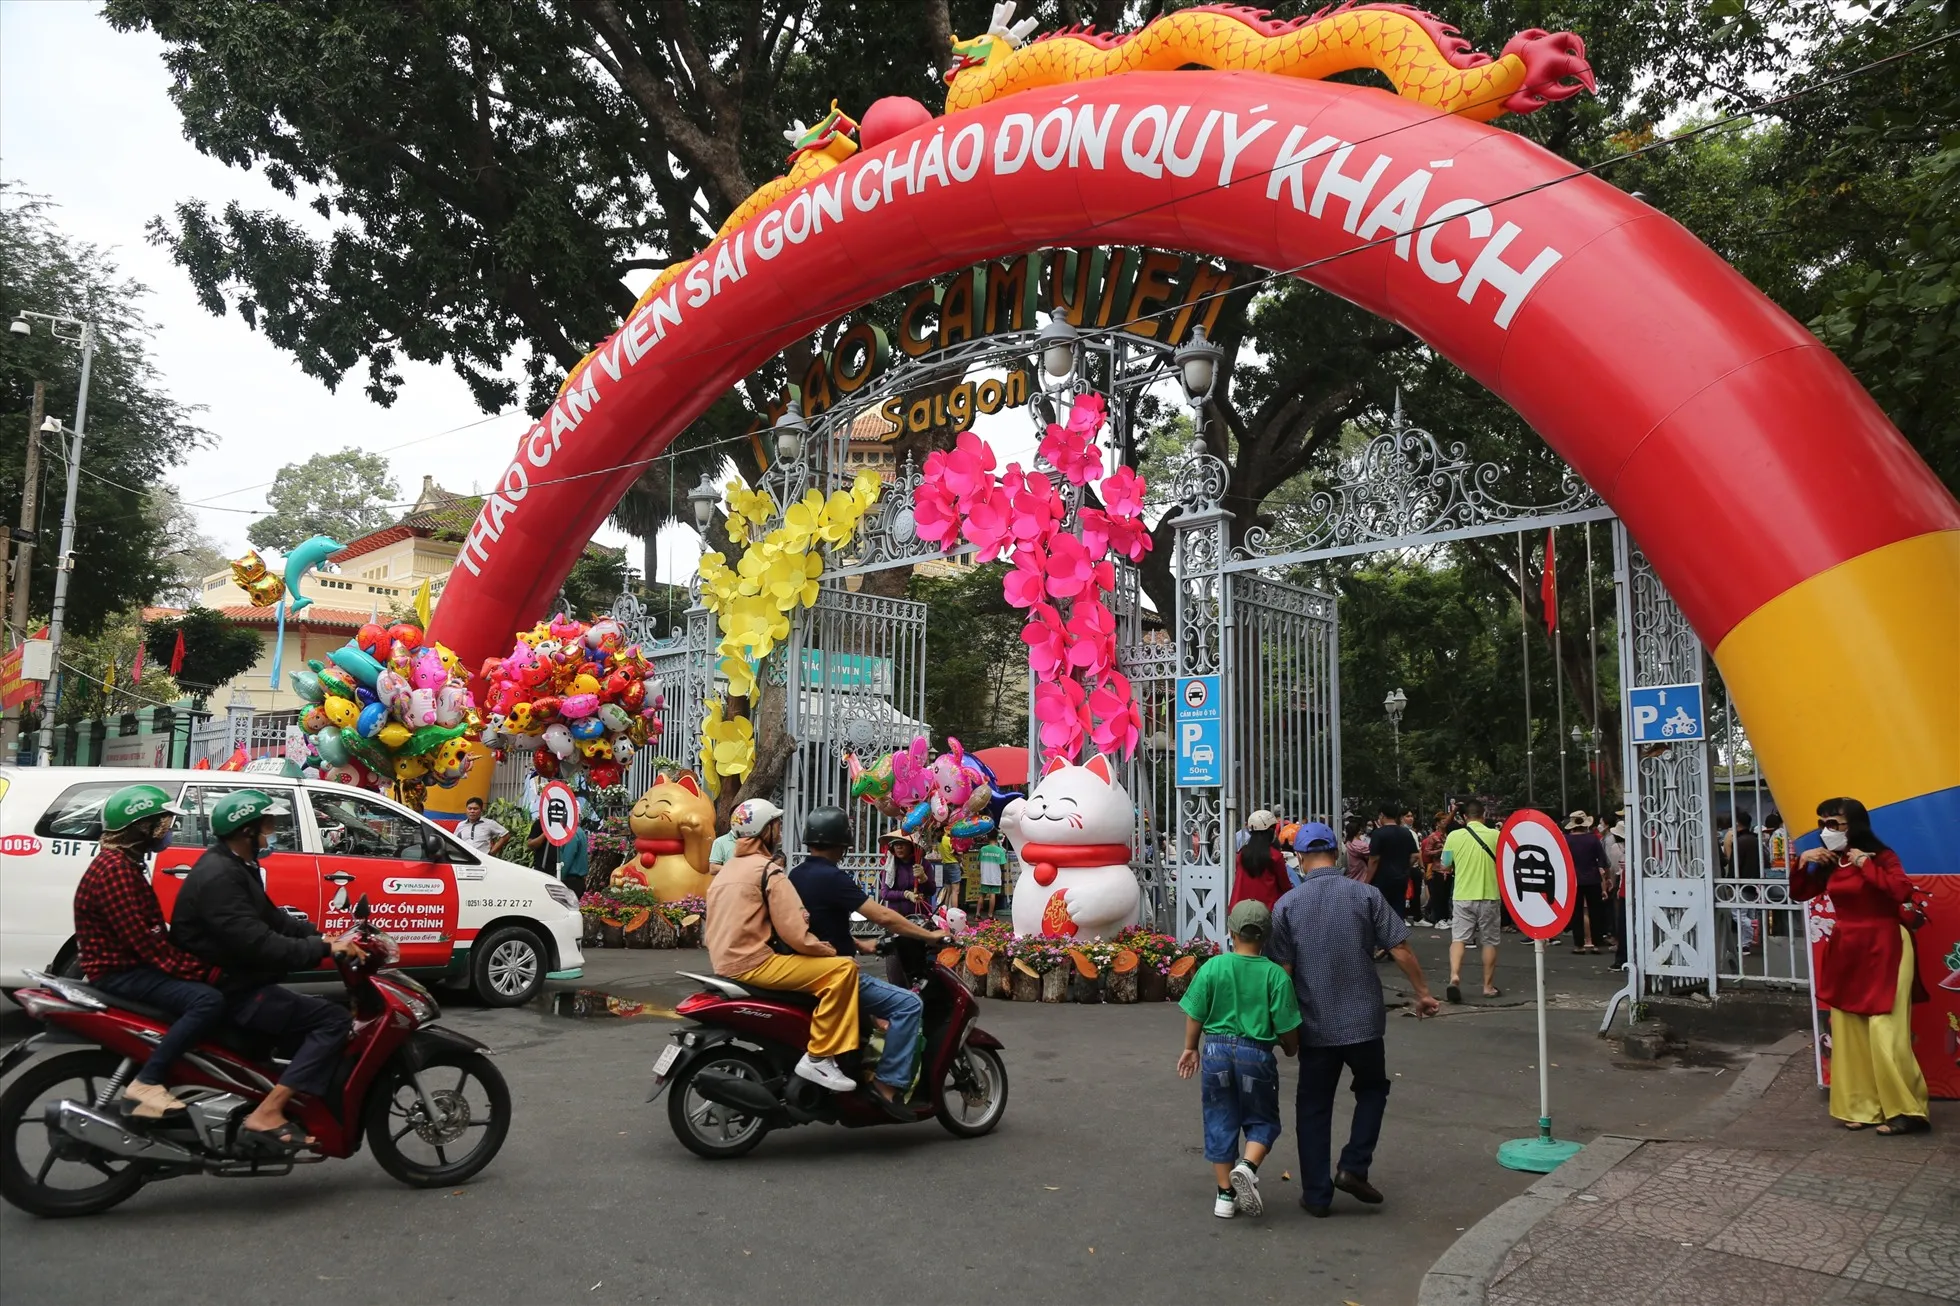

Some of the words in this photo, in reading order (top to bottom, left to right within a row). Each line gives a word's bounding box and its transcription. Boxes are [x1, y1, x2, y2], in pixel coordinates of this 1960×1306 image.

[994, 94, 1120, 176] ĐÓN
[1121, 104, 1278, 188] QUÝ
[1266, 124, 1563, 331] KHÁCH
[880, 369, 1026, 442] Saigon
[1633, 705, 1658, 739] P
[1182, 723, 1202, 757] P
[125, 800, 154, 815] Grab
[227, 803, 256, 822] Grab
[51, 840, 81, 856] 51F
[398, 902, 415, 914] ỔN
[417, 903, 445, 917] ĐỊNH
[510, 899, 520, 907] 27
[522, 899, 533, 907] 27
[325, 916, 350, 929] BIẾT
[394, 918, 409, 930] LỘ
[411, 917, 444, 929] TRÌNH
